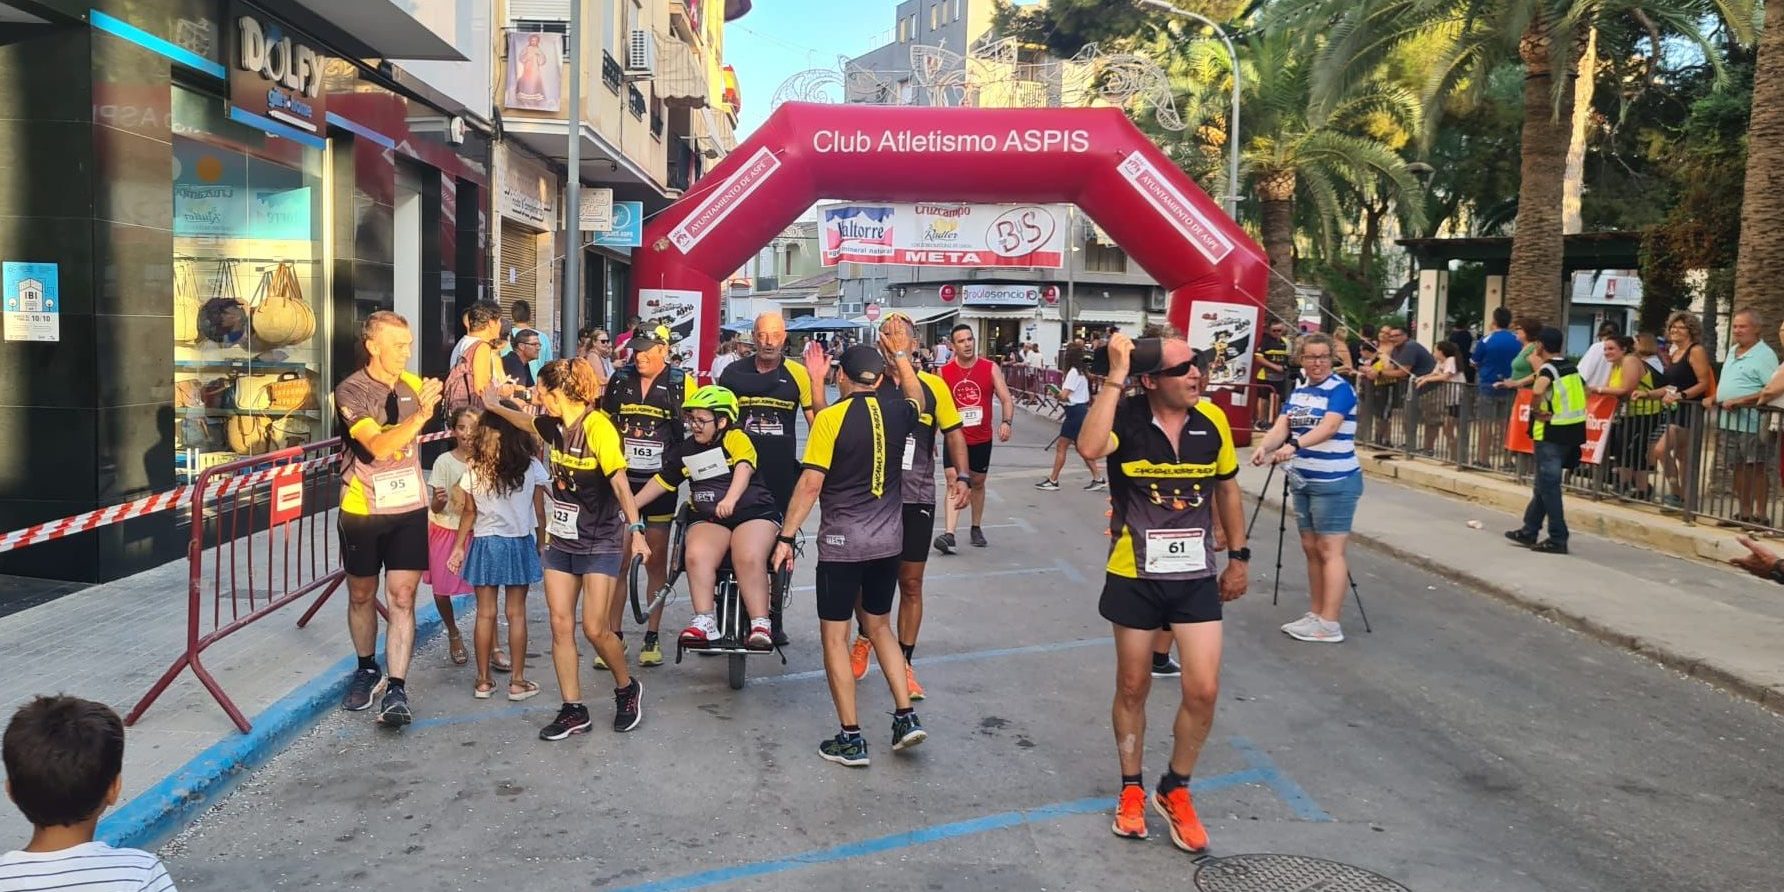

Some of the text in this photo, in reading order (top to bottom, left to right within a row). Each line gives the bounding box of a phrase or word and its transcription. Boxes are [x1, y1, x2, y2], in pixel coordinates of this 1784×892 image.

[239, 16, 325, 98] DOLFY
[813, 129, 1090, 153] Club Atletismo ASPIS
[690, 160, 767, 233] AYUNTAMIENTO DE ASPE
[915, 205, 971, 218] Cruzcampo
[1141, 175, 1219, 252] AYUNTAMIENTO DE ASPE
[841, 246, 867, 254] mineral
[869, 247, 892, 255] natural
[905, 251, 981, 263] META
[25, 291, 38, 300] IBI
[633, 447, 652, 457] 163
[389, 479, 406, 490] 95
[1168, 541, 1185, 554] 61
